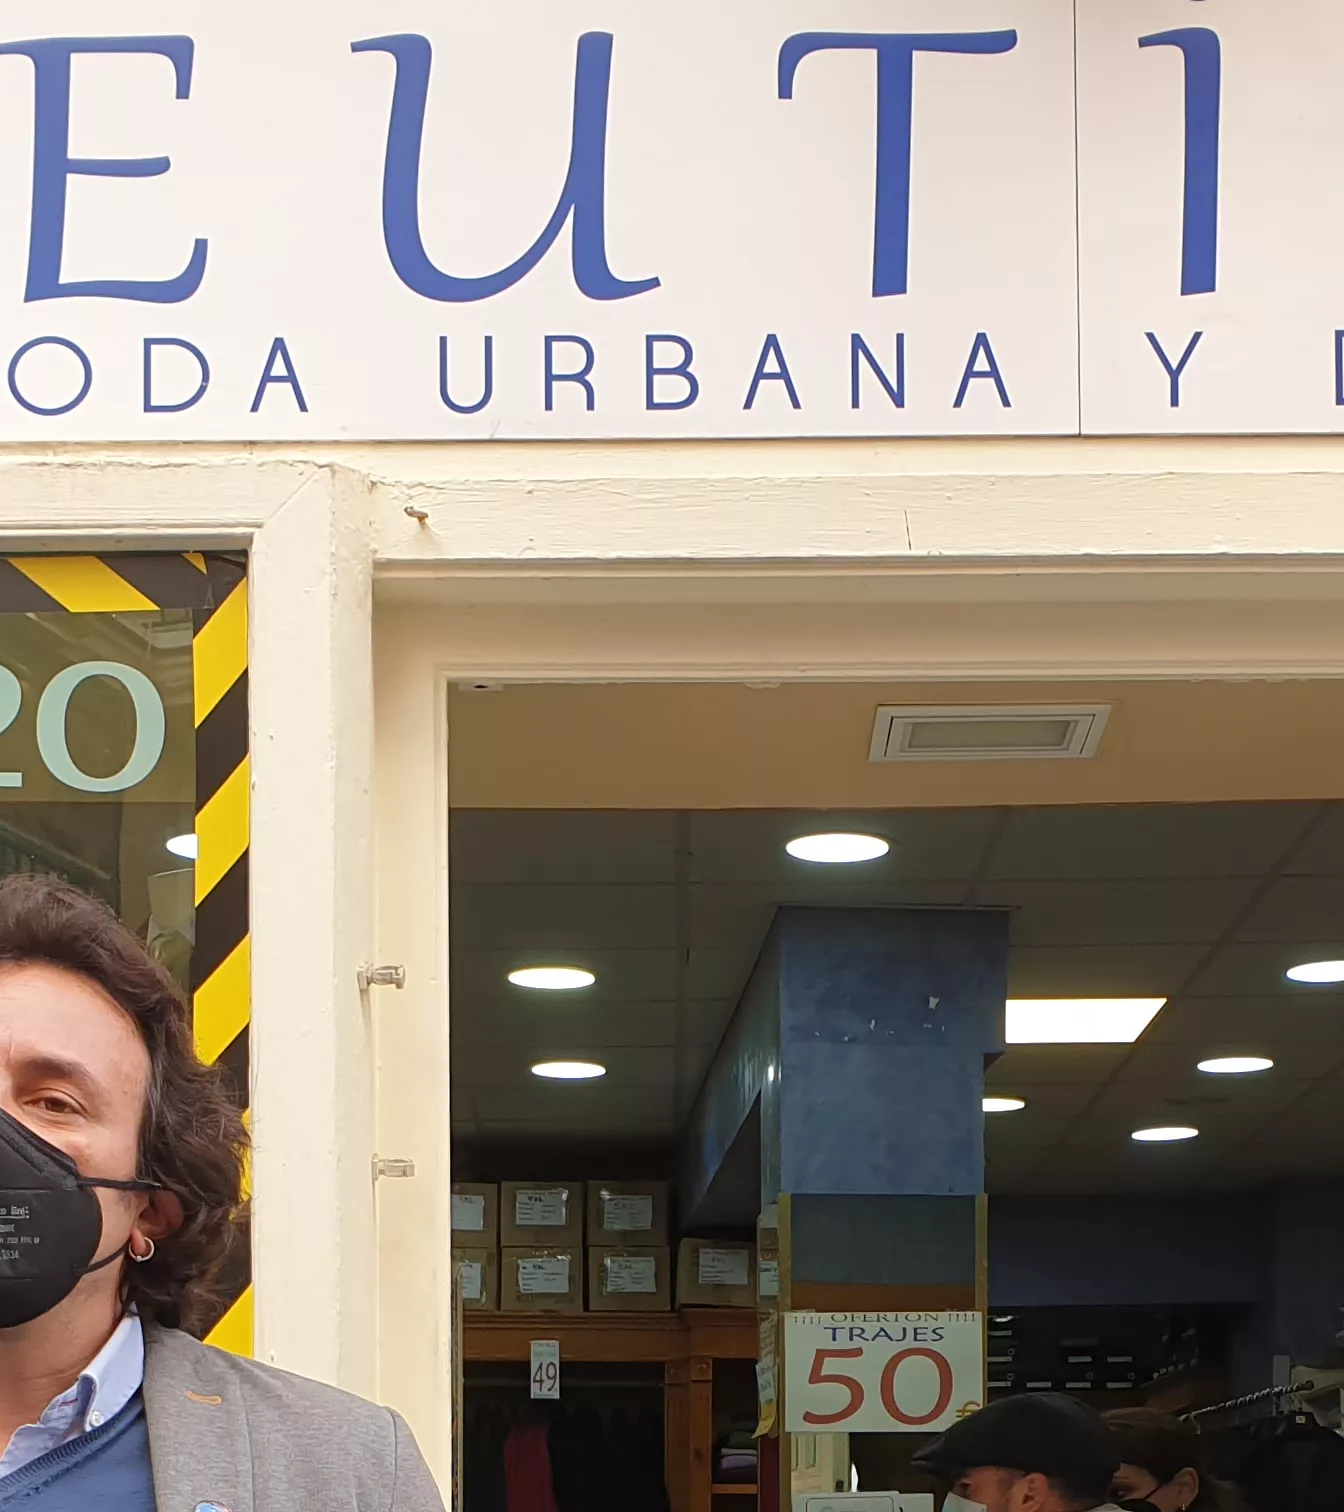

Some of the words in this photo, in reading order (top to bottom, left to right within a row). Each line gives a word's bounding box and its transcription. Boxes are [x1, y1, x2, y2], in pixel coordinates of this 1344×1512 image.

[439, 332, 1013, 415] URBANA
[1144, 331, 1204, 409] Y
[823, 1326, 945, 1343] TRAJES
[532, 1361, 558, 1393] 49
[802, 1346, 954, 1426] 50
